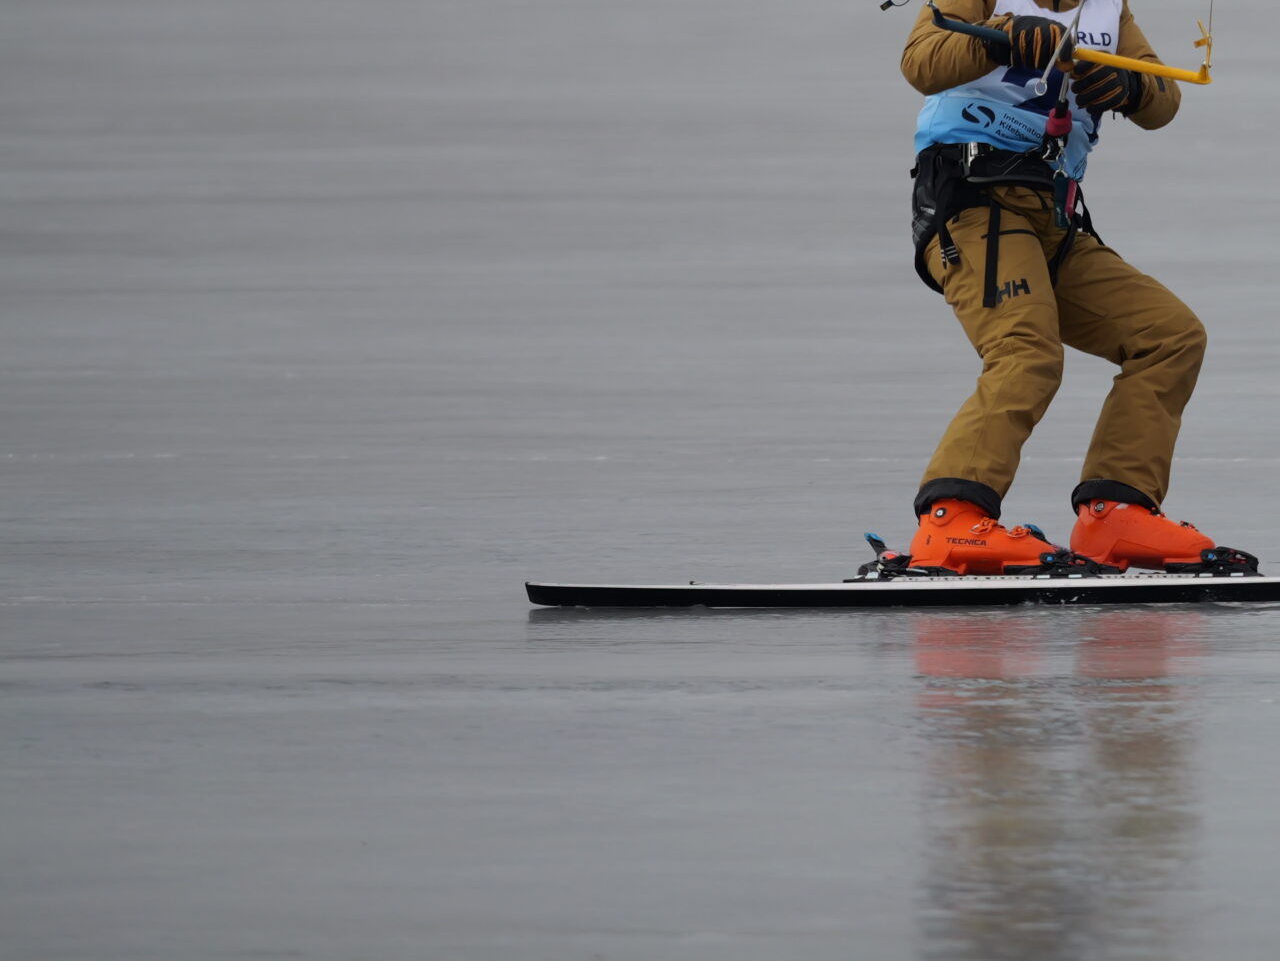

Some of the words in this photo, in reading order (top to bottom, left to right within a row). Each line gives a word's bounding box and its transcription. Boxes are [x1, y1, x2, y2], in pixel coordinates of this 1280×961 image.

[1076, 31, 1112, 47] RLD
[1003, 113, 1042, 139] Internatio
[946, 537, 987, 546] TECNICA
